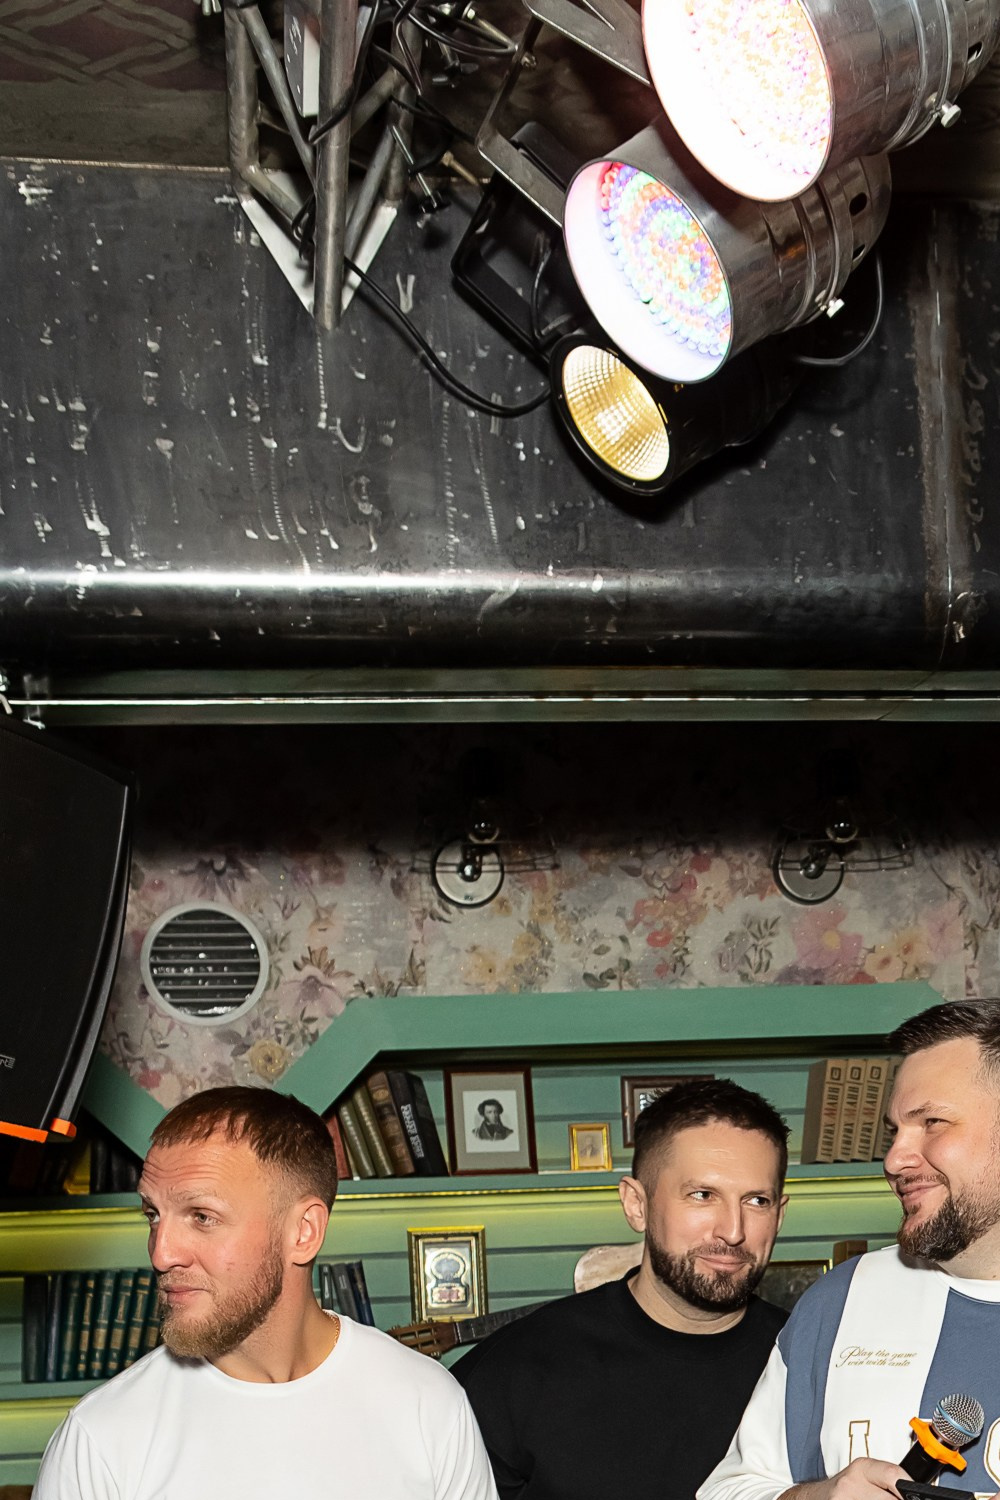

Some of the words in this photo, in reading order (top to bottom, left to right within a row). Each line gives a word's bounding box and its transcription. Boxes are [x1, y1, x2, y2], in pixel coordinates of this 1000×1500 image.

[823, 1086, 840, 1118] МАНН
[844, 1085, 860, 1118] МАНН
[862, 1084, 880, 1117] МАНН
[836, 1346, 873, 1368] Play
[875, 1349, 890, 1358] the
[891, 1352, 918, 1361] game
[865, 1358, 887, 1366] with
